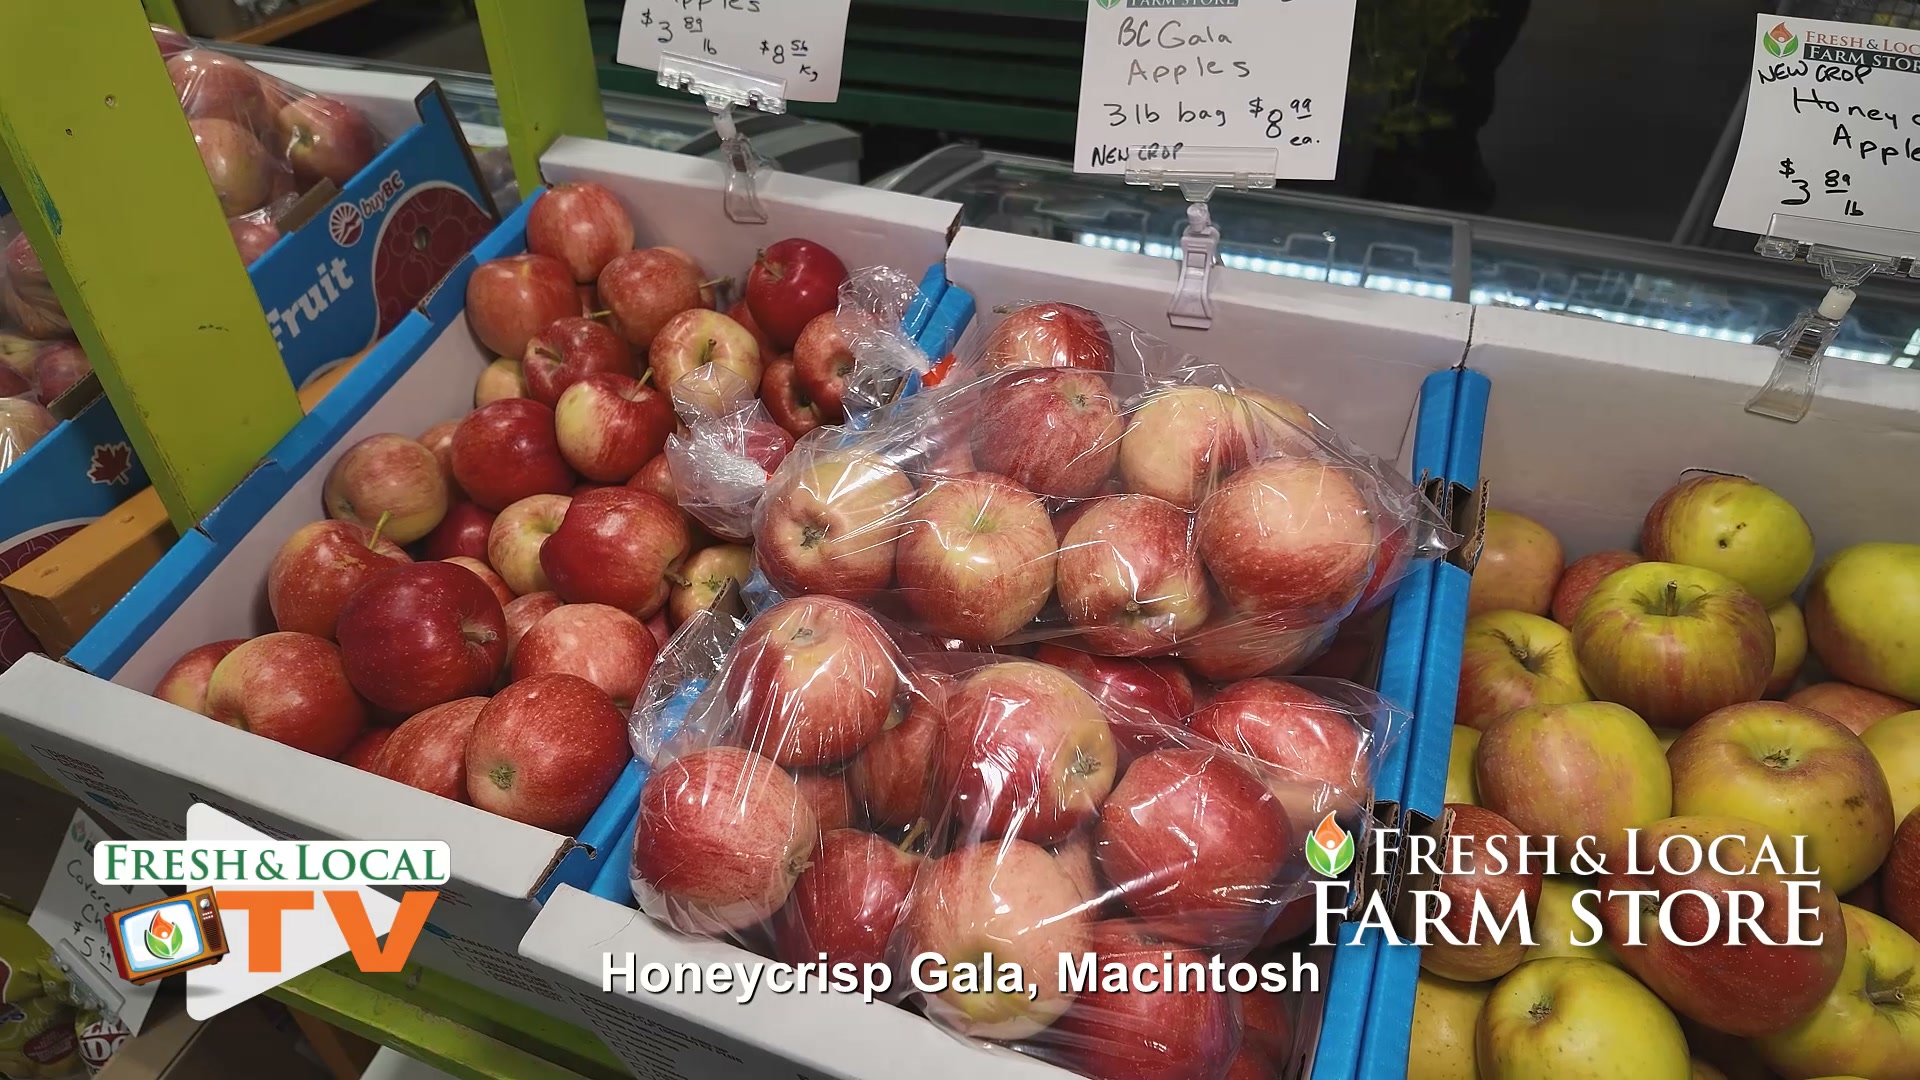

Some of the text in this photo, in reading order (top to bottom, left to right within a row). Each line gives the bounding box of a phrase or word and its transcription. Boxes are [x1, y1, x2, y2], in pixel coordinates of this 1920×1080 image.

[1118, 16, 1232, 49] BC Gala
[1806, 31, 1864, 48] FRESH
[1866, 39, 1880, 50] &
[1808, 46, 1866, 65] FARM
[1128, 56, 1250, 86] Apples
[1758, 60, 1872, 84] NEW CROP
[1178, 101, 1226, 127] bag
[1092, 142, 1184, 168] NEW CROP
[1844, 199, 1864, 216] lb
